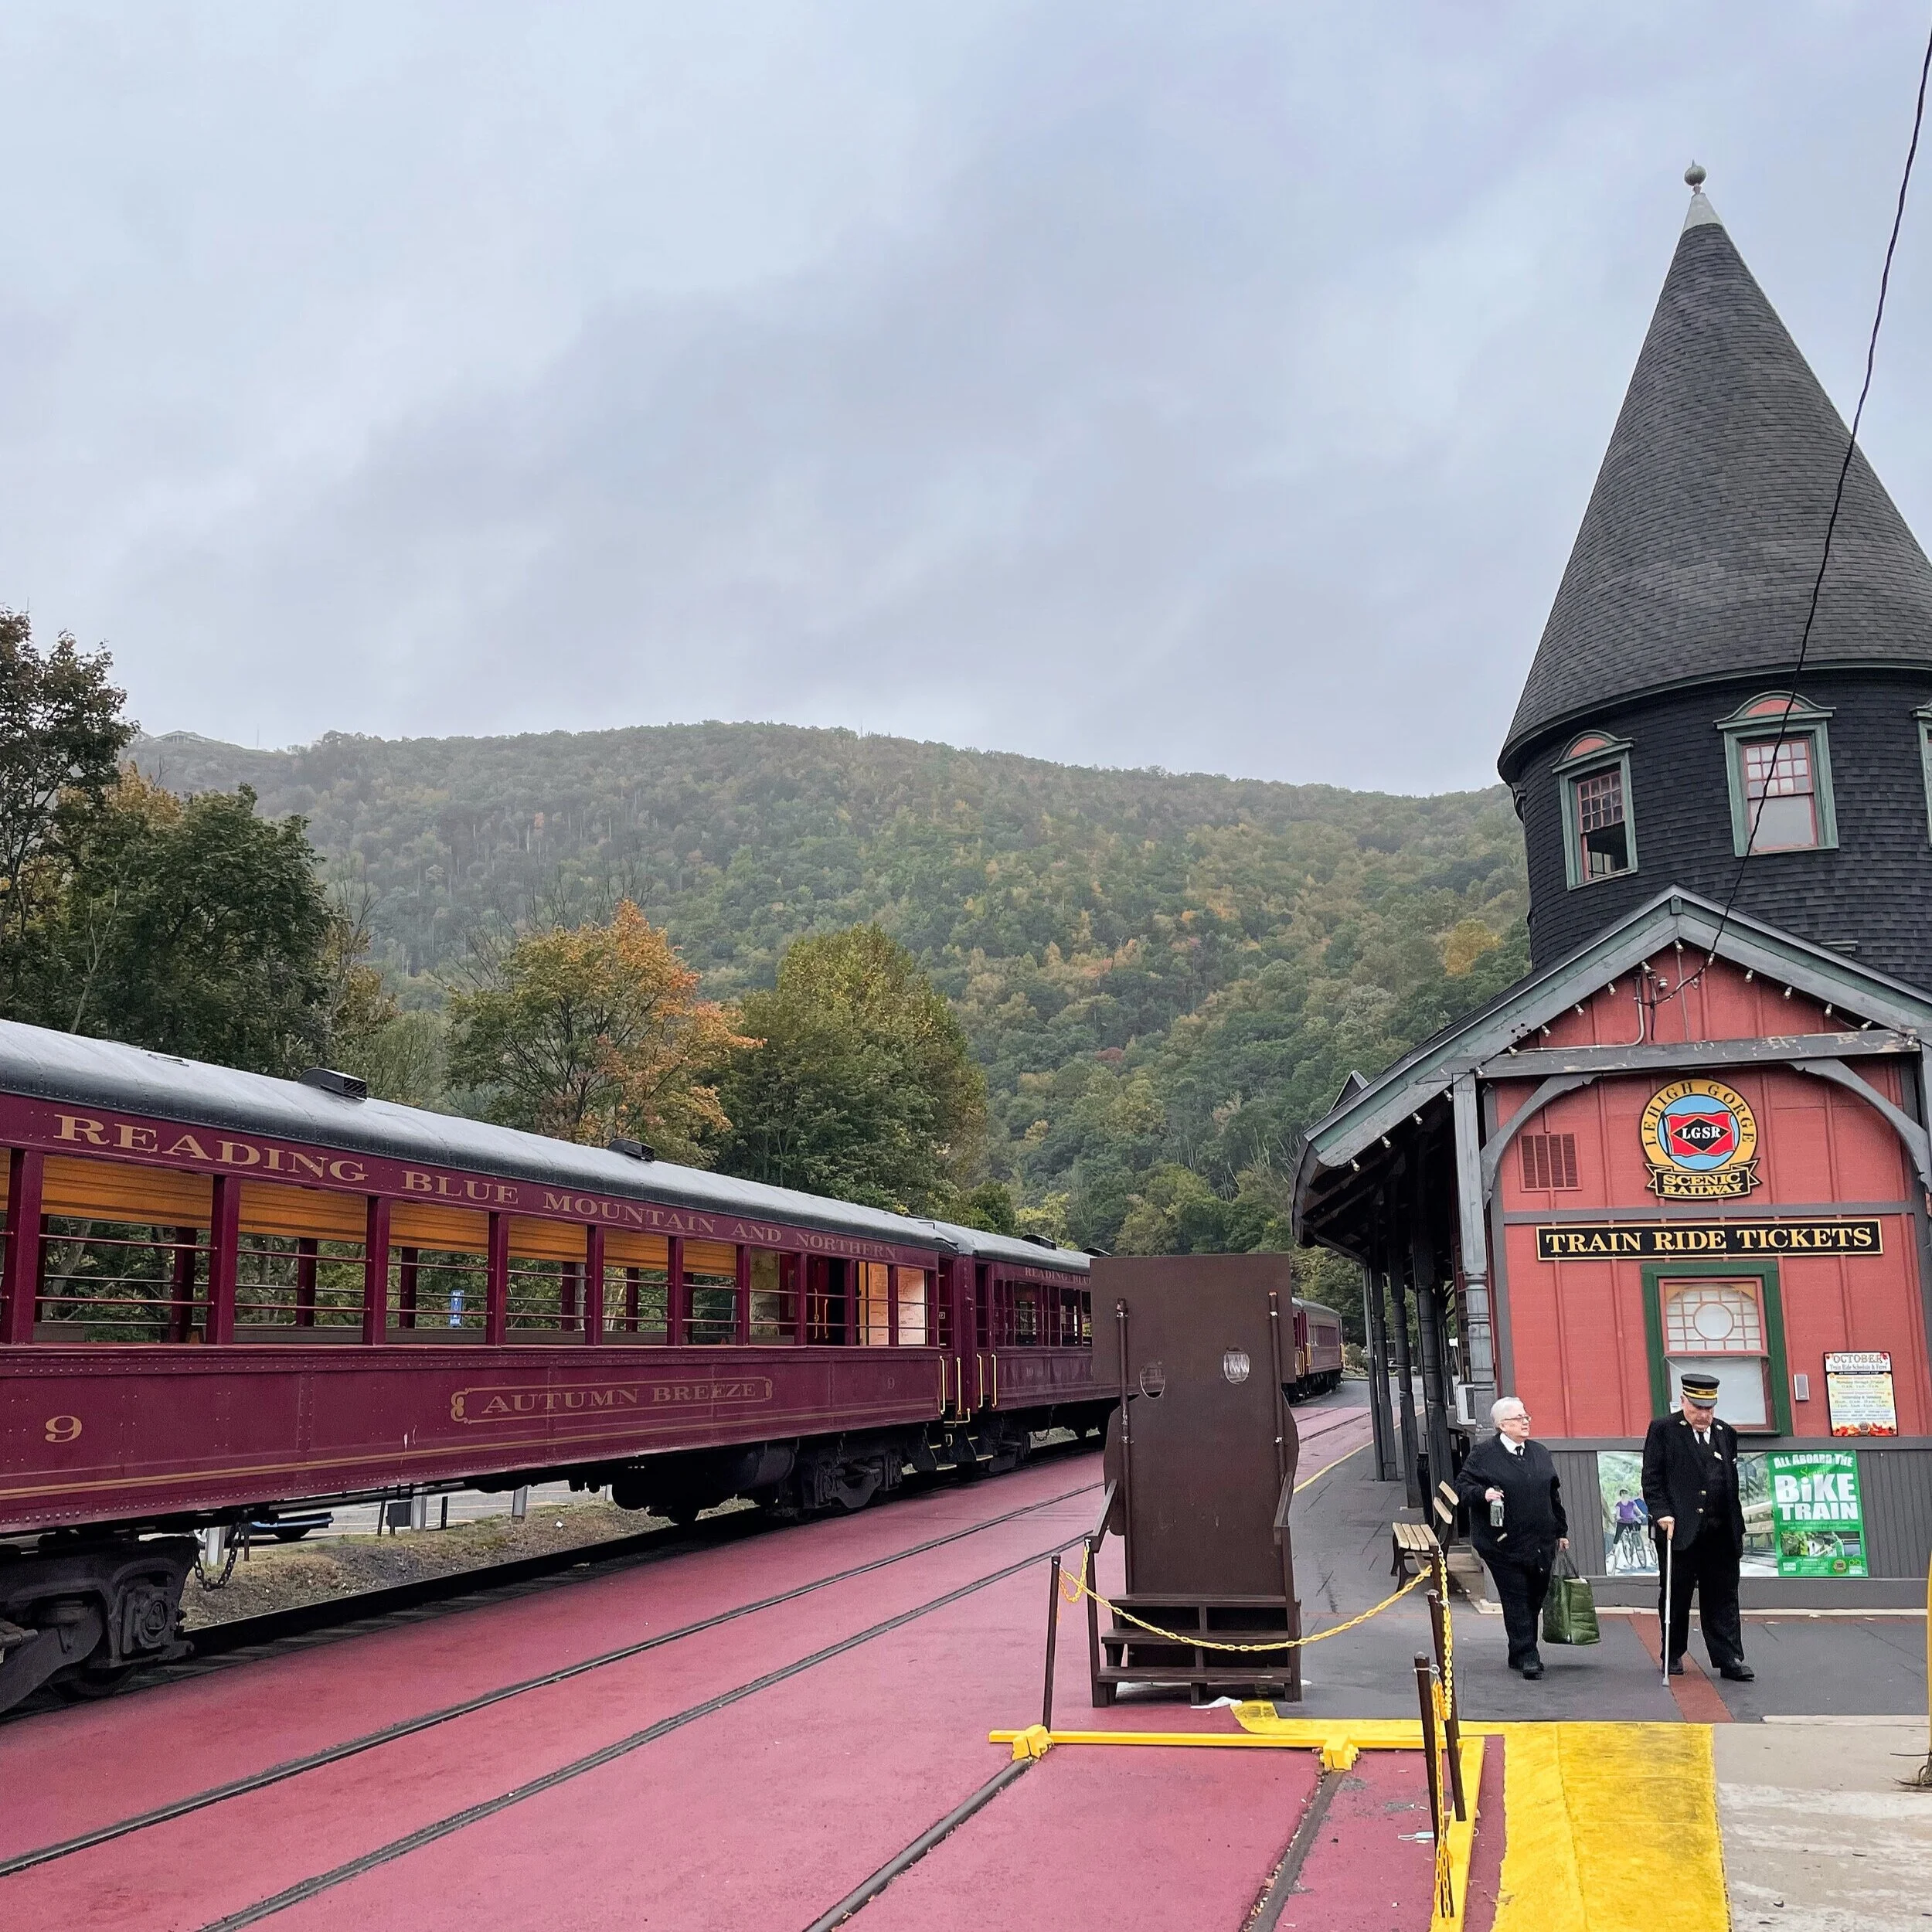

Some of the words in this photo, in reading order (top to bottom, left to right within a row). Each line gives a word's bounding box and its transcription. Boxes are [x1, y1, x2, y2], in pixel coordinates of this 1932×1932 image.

[1644, 1082, 1693, 1146] LEHIGH
[1708, 1084, 1755, 1143] GORGE
[1682, 1126, 1721, 1139] LGSR
[53, 1114, 369, 1182] READING
[401, 1170, 519, 1204] BLUE
[543, 1192, 716, 1233] MOUNTAIN
[731, 1223, 781, 1243] AND
[796, 1233, 896, 1259] NORTHERN
[1663, 1172, 1740, 1185] SCENIC
[1663, 1184, 1743, 1195] RAILWAY
[1546, 1233, 1642, 1253] TRAIN
[1652, 1230, 1727, 1250] RIDE
[1736, 1227, 1872, 1249] TICKETS
[1025, 1267, 1067, 1281] READING
[1833, 1354, 1883, 1364] OCTOBER
[481, 1388, 639, 1413] AUTUMN
[652, 1383, 757, 1402] BREEZE
[45, 1415, 83, 1443] 9
[1774, 1457, 1792, 1469] ALL
[1792, 1454, 1832, 1465] ABOARD
[1834, 1453, 1853, 1467] THE
[1777, 1502, 1859, 1521] TRAIN
